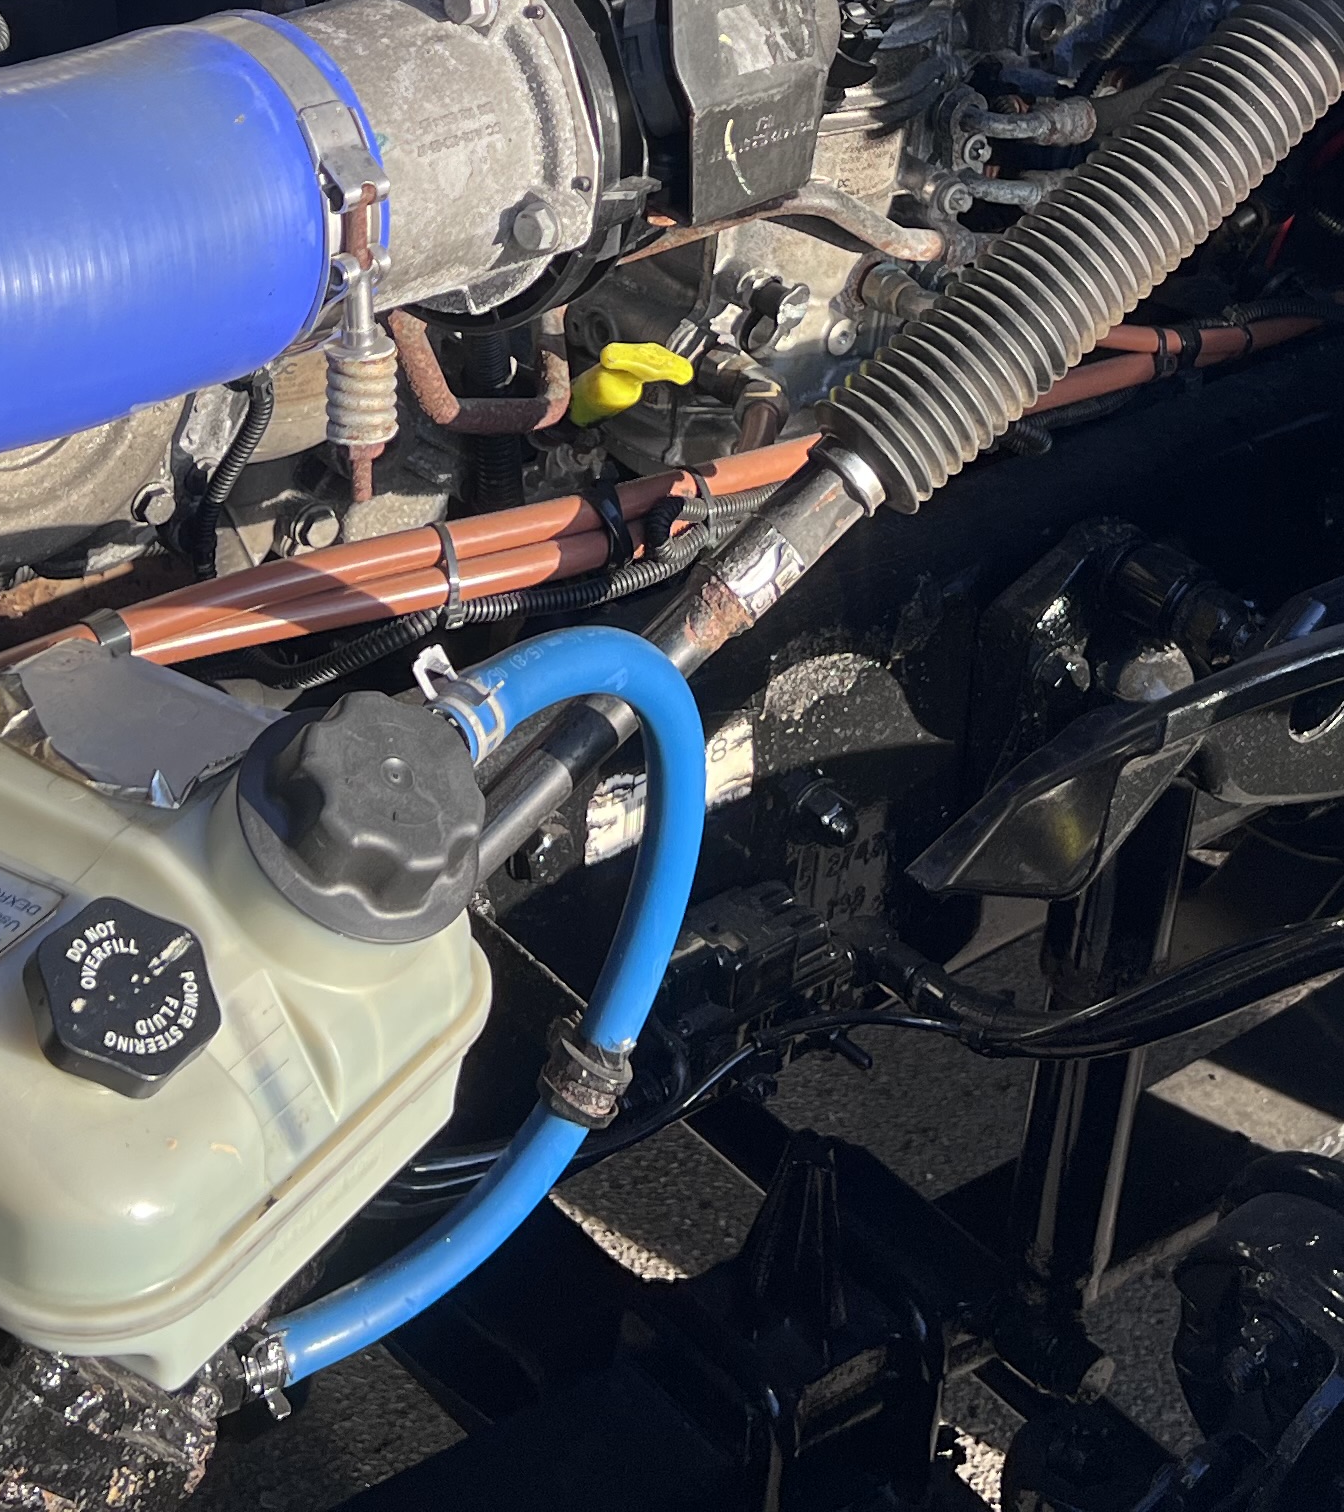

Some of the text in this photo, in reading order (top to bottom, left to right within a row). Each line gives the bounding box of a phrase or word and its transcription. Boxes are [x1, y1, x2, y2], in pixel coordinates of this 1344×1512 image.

[65, 919, 117, 963] DO NOT
[80, 937, 140, 990] OVERFILL
[103, 970, 199, 1055] POWER STEERING
[135, 995, 180, 1037] FLUID
